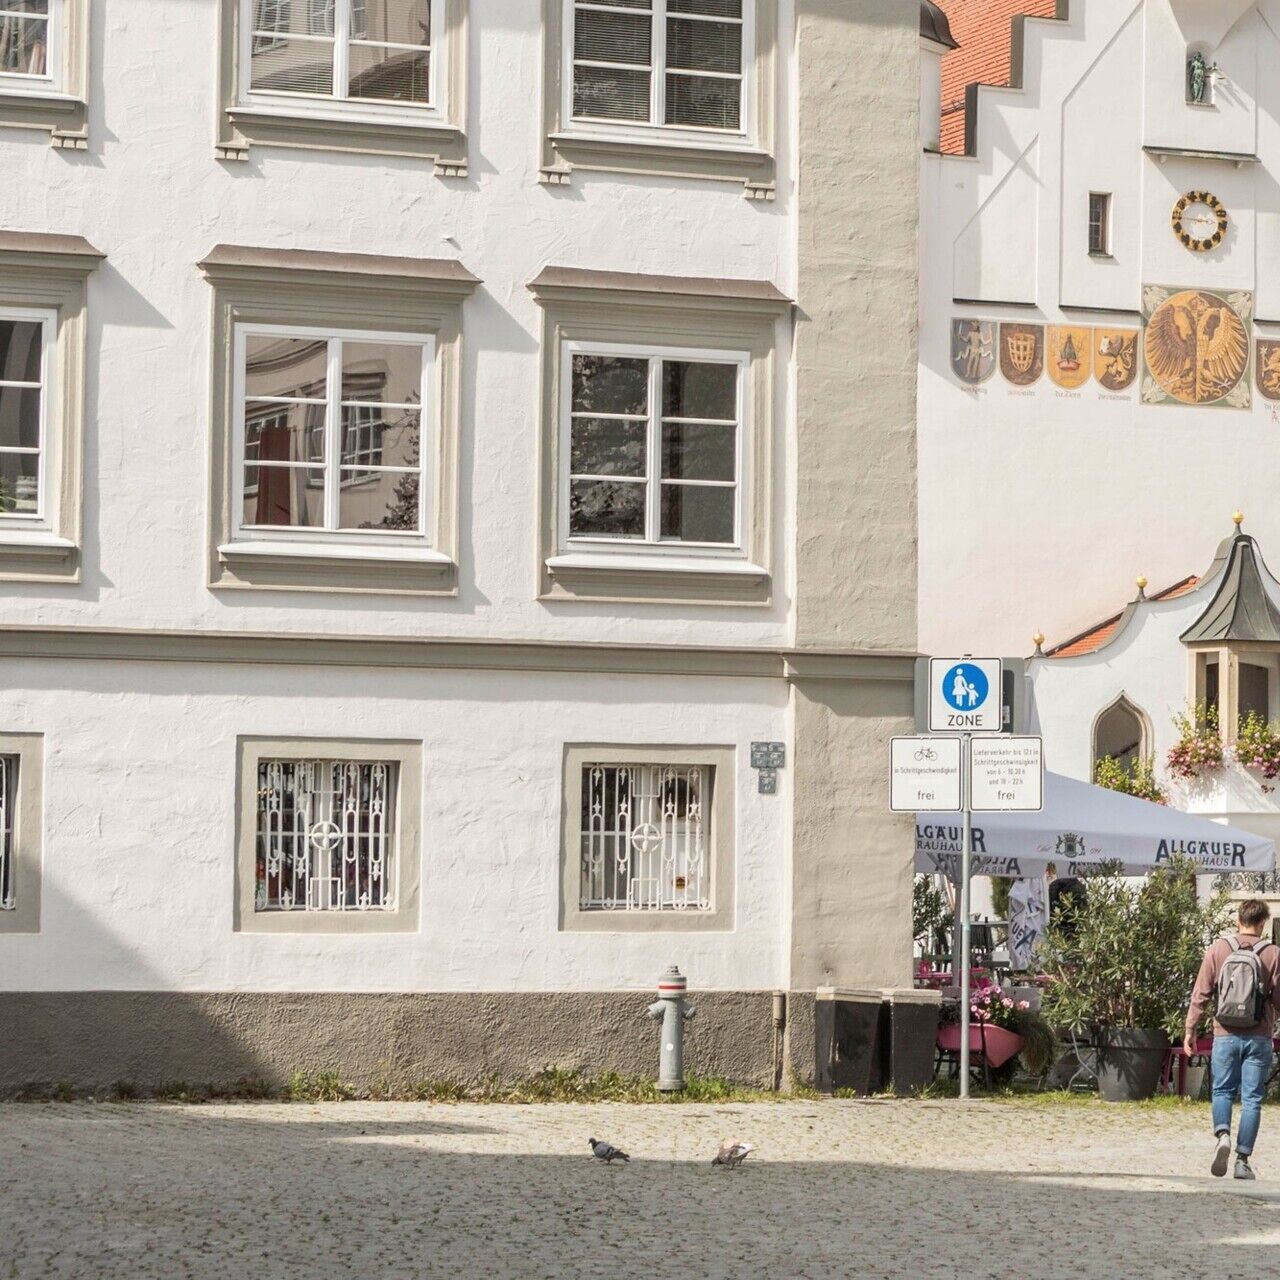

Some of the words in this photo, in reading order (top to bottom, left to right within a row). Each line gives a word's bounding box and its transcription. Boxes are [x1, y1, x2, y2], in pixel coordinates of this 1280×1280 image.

[947, 715, 983, 726] ZONE
[900, 767, 957, 775] Schrittgeschwindigkeit
[917, 789, 935, 800] frei
[997, 789, 1015, 800] frei
[916, 824, 986, 852] LGÄUR
[1155, 839, 1246, 867] ALLGÄUER
